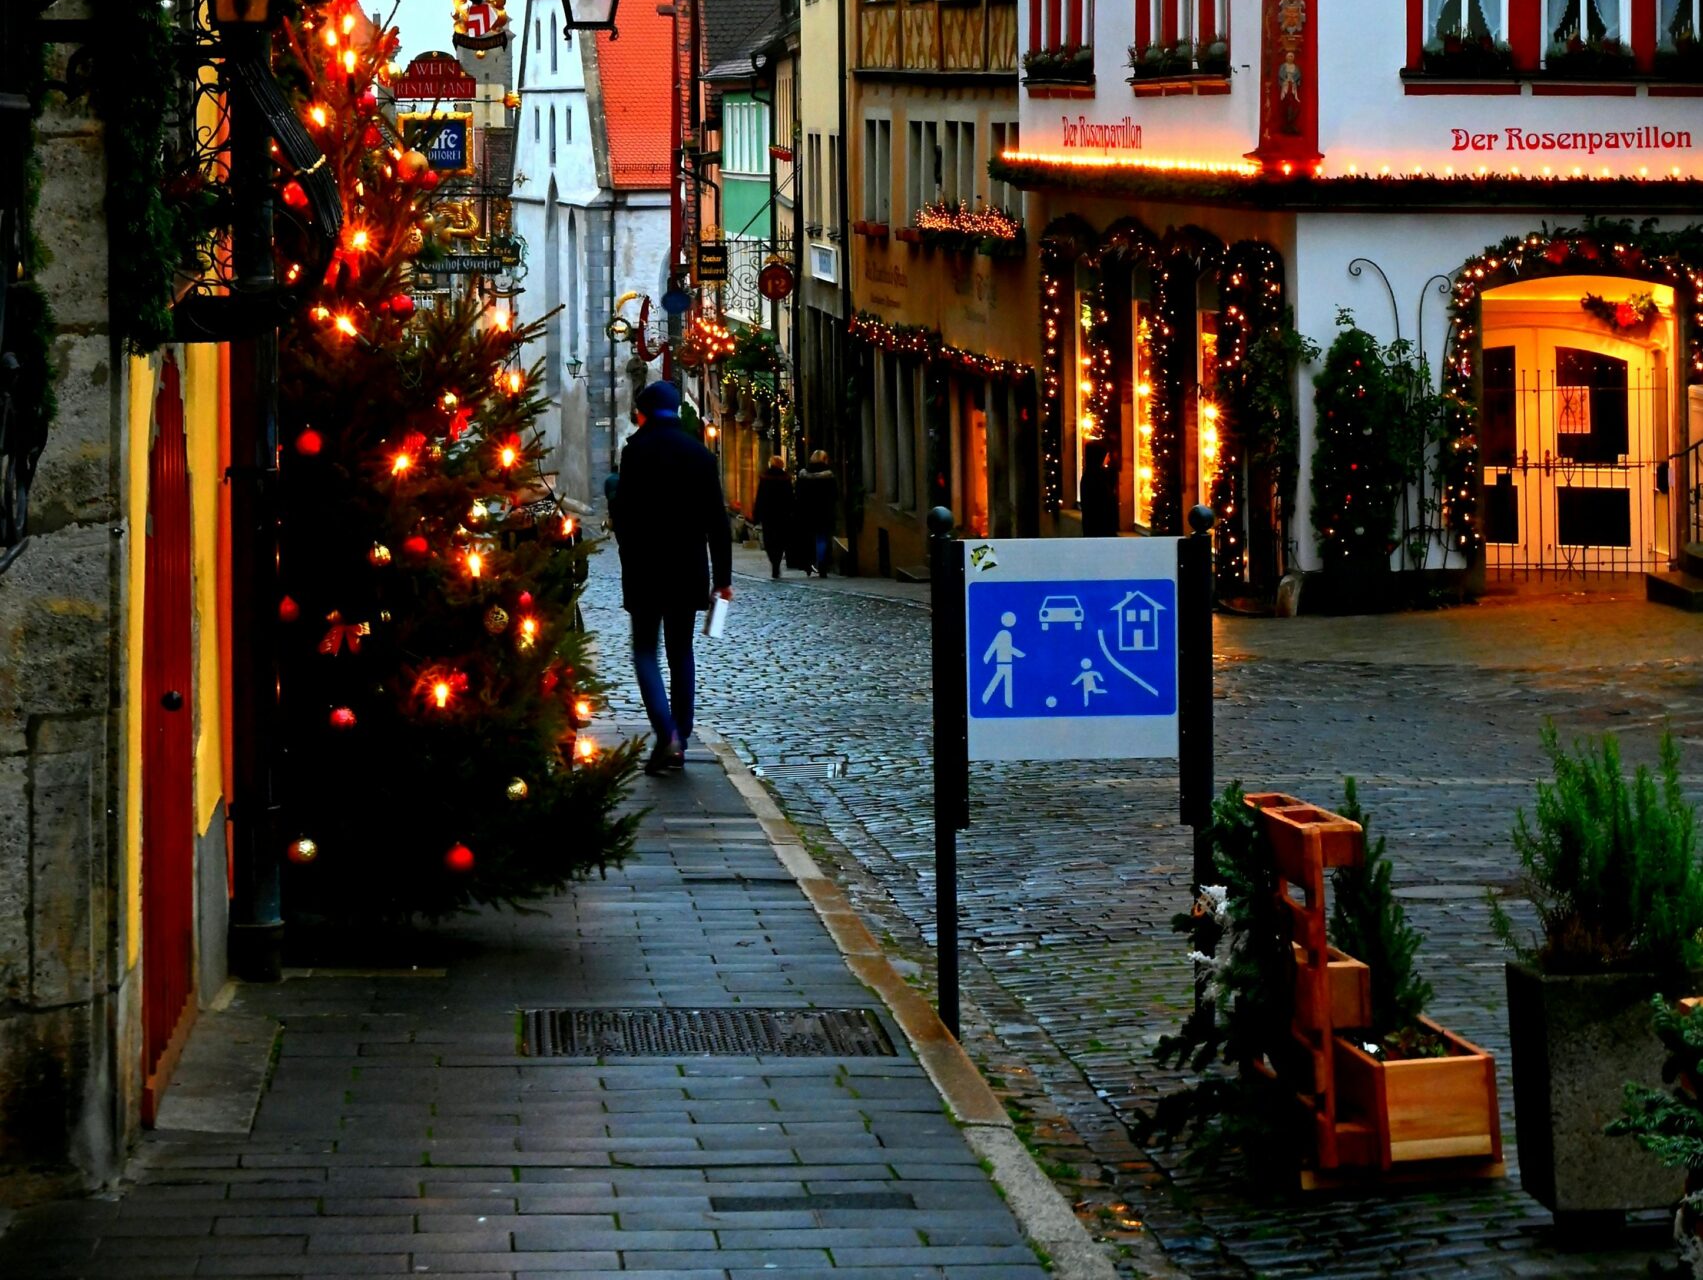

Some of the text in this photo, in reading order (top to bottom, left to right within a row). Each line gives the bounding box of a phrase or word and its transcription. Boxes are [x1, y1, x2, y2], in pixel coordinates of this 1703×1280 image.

[414, 62, 456, 76] WEIN
[396, 81, 473, 95] RESTAURANT
[1062, 116, 1142, 156] Der Rosenpavillon
[1451, 126, 1692, 155] Der Rosenpavillon
